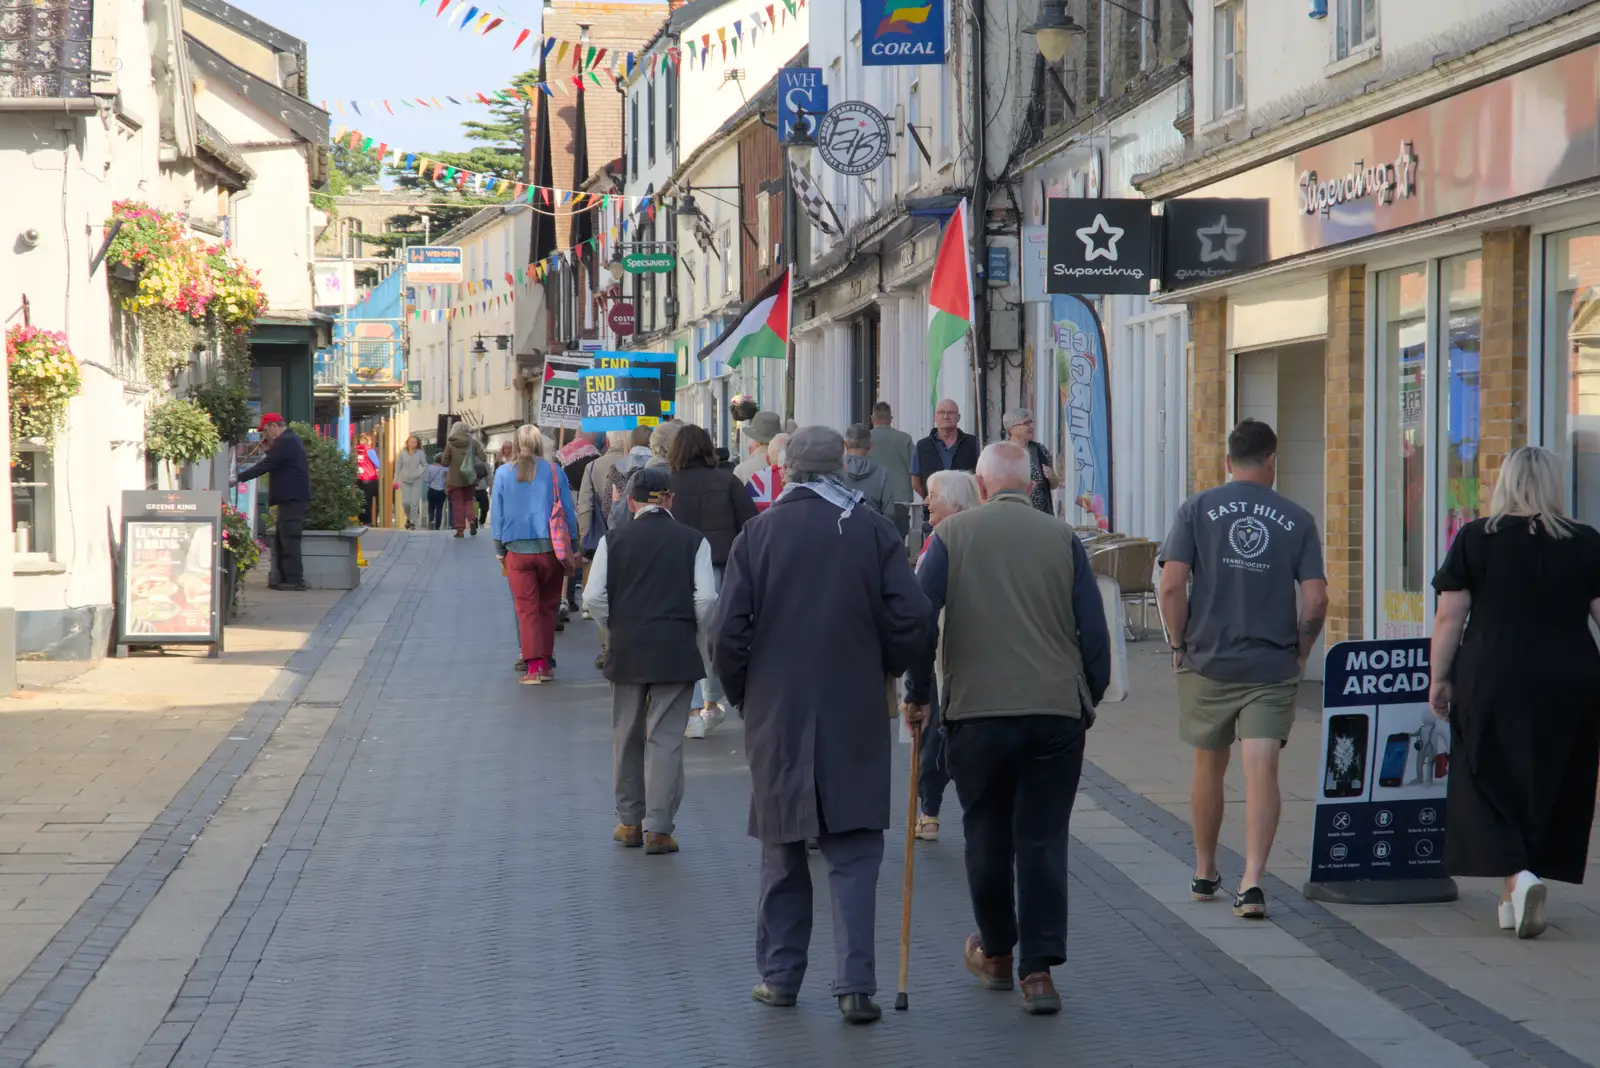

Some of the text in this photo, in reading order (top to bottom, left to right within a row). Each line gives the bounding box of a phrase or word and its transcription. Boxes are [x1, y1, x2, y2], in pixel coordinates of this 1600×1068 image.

[871, 41, 935, 55] CORAL
[785, 73, 816, 87] WH
[832, 105, 866, 117] CRAFTED
[866, 110, 886, 135] BAKING
[821, 145, 839, 166] GREAT
[838, 164, 867, 172] COFFEE
[1299, 160, 1389, 220] Superdrug
[626, 258, 670, 267] Specsavers
[1053, 264, 1144, 278] Superdrug
[601, 358, 630, 368] END
[585, 375, 616, 393] END
[586, 391, 628, 404] ISRAELI
[541, 403, 580, 415] PALESTIN
[587, 404, 646, 418] APARTHEID
[177, 503, 197, 511] KING
[1207, 501, 1295, 531] EAST HILLS
[1222, 557, 1244, 565] TENNIS
[1345, 648, 1429, 671] MOBIL
[1342, 672, 1430, 695] ARCAD
